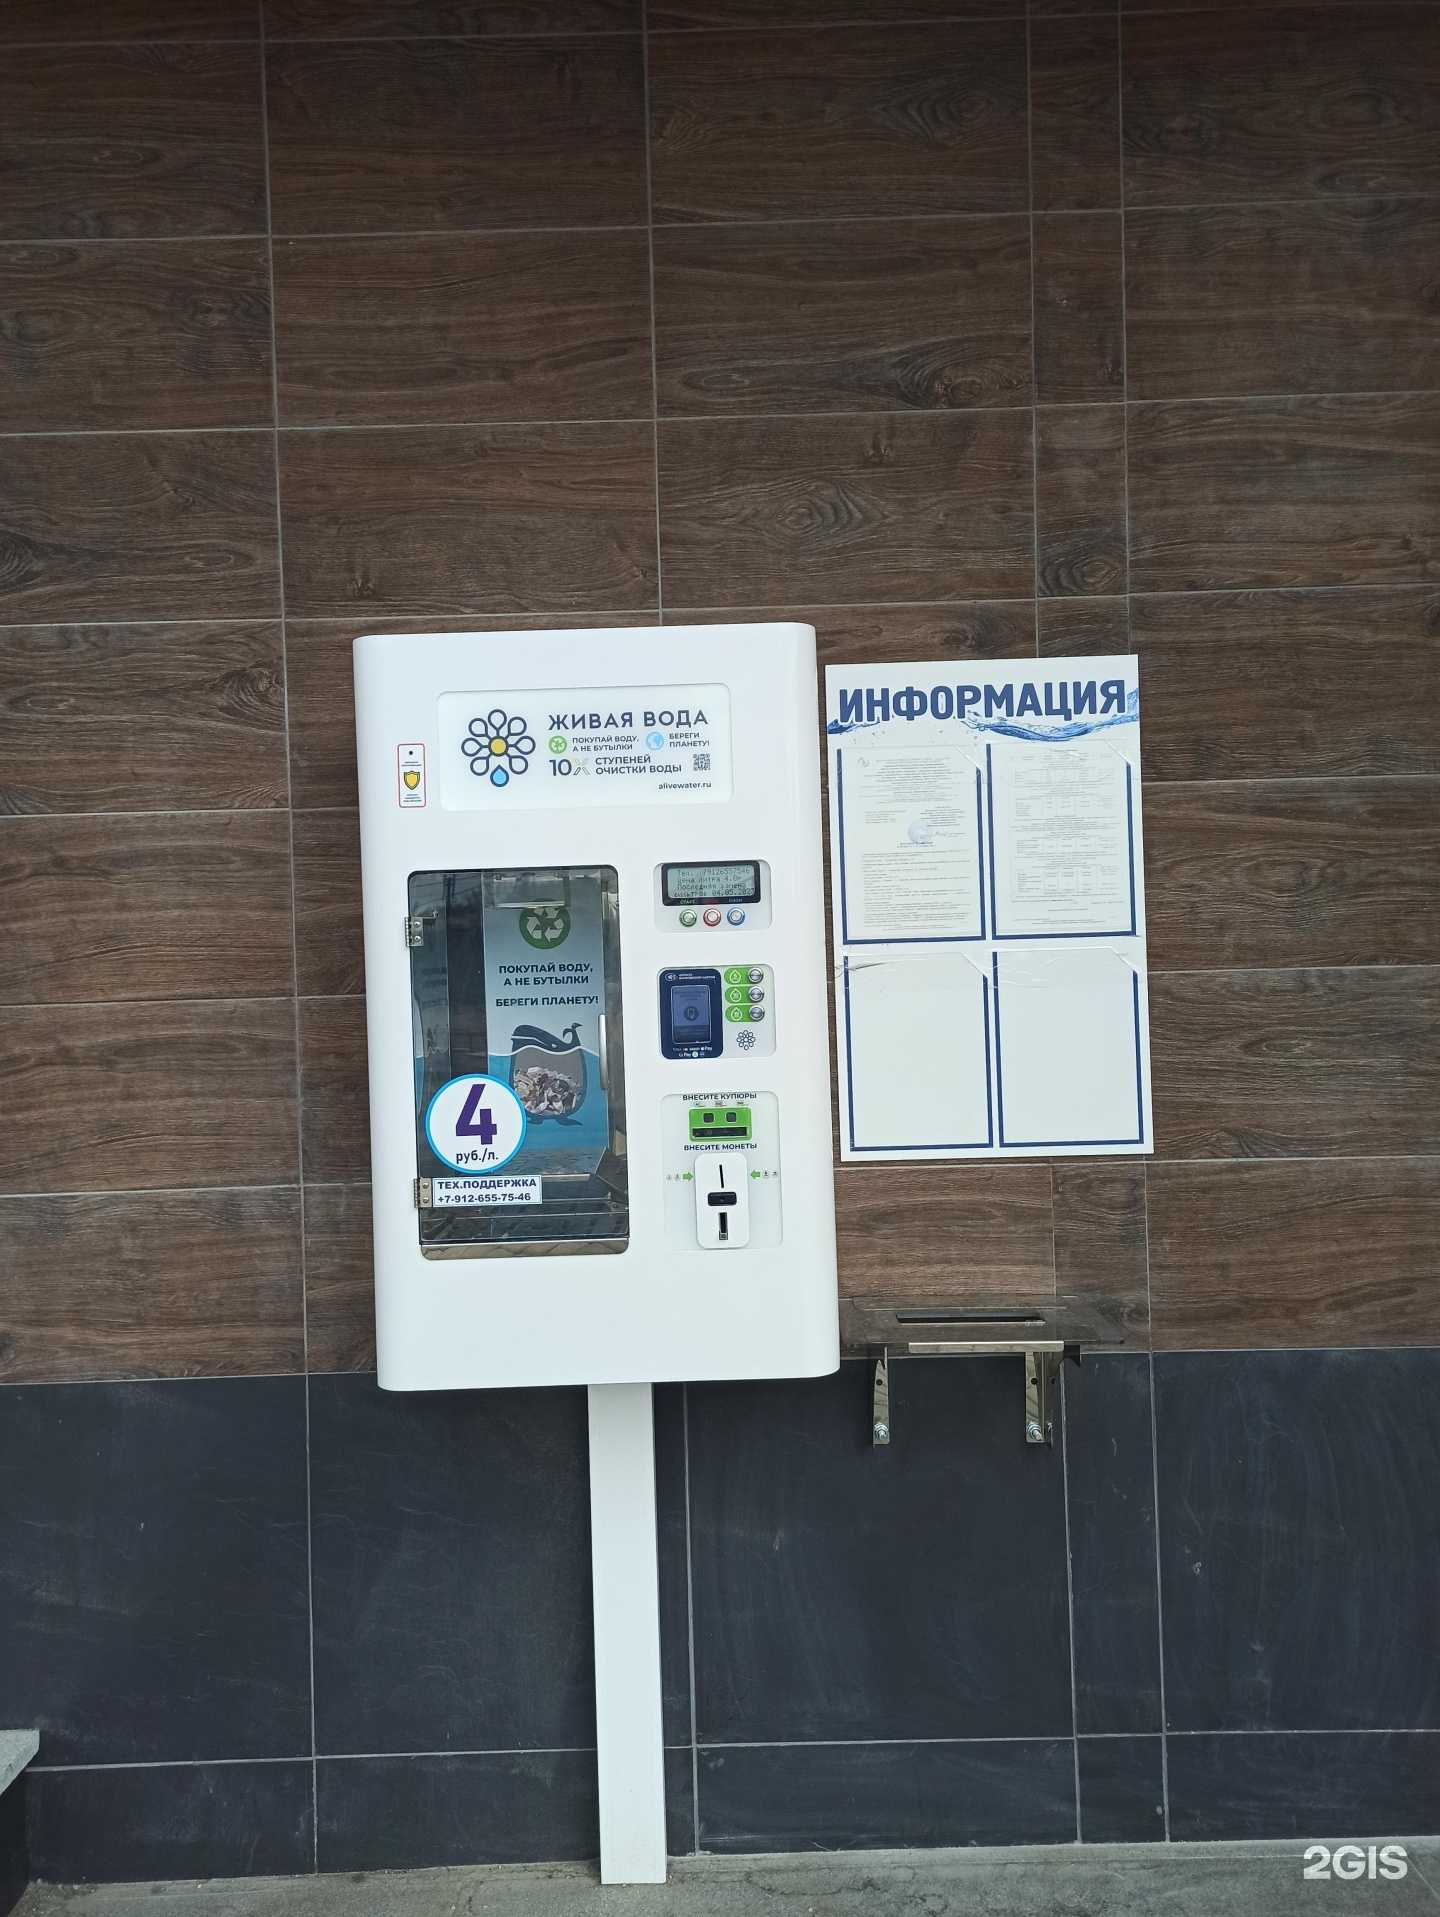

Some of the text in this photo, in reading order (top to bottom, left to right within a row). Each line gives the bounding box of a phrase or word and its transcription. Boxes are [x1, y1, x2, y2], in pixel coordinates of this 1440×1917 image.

[839, 679, 1126, 722] ИНФОРМАЦИЯ
[548, 709, 709, 730] ЖИВАЯ ВОДА
[572, 734, 639, 744] ПОКУПАЙ ВОДУ,
[669, 732, 700, 740] БЕРЕГИ
[593, 744, 633, 752] БУТЫЛКИ
[669, 740, 710, 748] ПЛАНЕТУ!
[595, 753, 651, 765] СТУПЕНЕЙ
[595, 764, 682, 775] ОЧИСТКИ ВОДЫ
[658, 782, 712, 790] alivewater.ru
[498, 962, 593, 974] ПОКУПАЙ ВОДУ,
[503, 975, 589, 986] А НЕ БУТЫЛКИ
[495, 995, 599, 1007] БЕРЕГИ ПЛАНЕТУ!
[682, 1092, 757, 1101] ВНЕСИТЕ КУПЮРЫ
[455, 1083, 497, 1145] 4
[456, 1148, 499, 1164] руб./л.
[437, 1178, 537, 1190] ТЕХ.ПОДДЕРЖКА
[437, 1192, 531, 1203] +7-912-655-75-46
